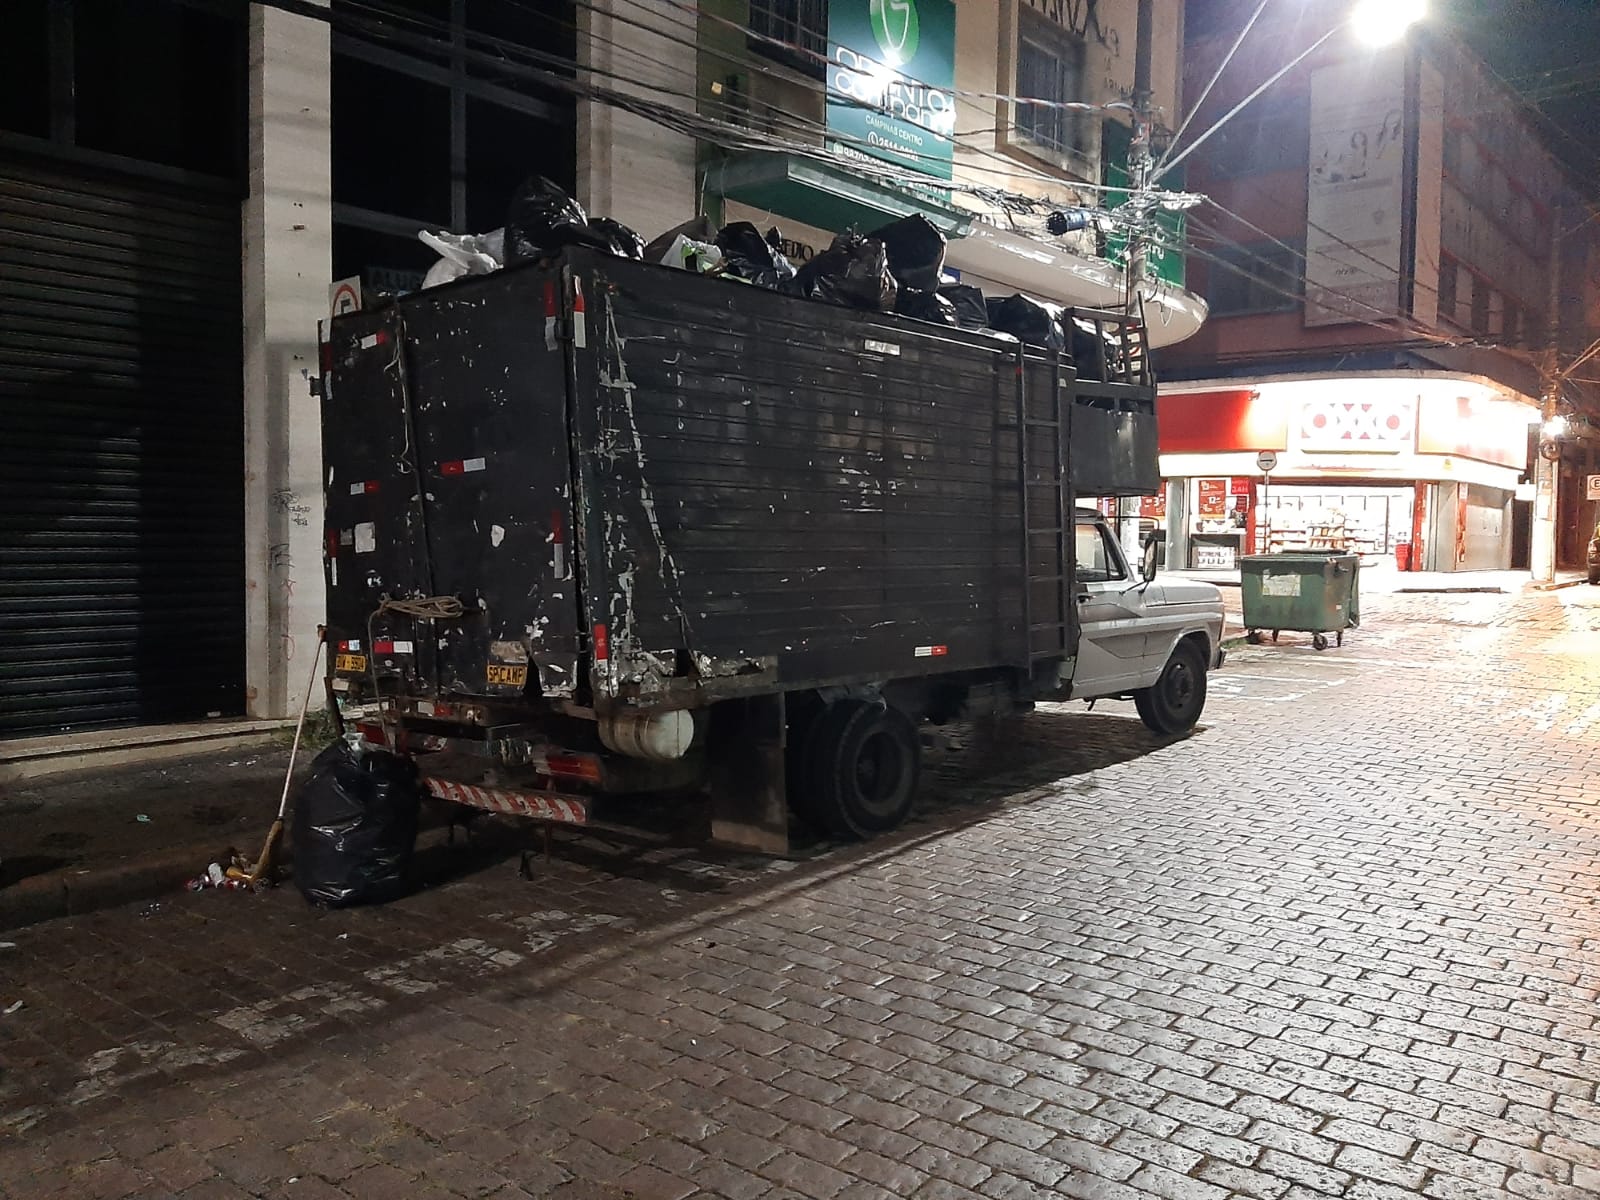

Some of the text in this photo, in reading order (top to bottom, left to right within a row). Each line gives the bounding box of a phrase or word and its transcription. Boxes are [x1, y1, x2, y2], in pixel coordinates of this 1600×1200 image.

[865, 115, 923, 147] CAMPINAS CENTRO
[1301, 402, 1411, 441] OXXO
[500, 667, 523, 684] CAMP
